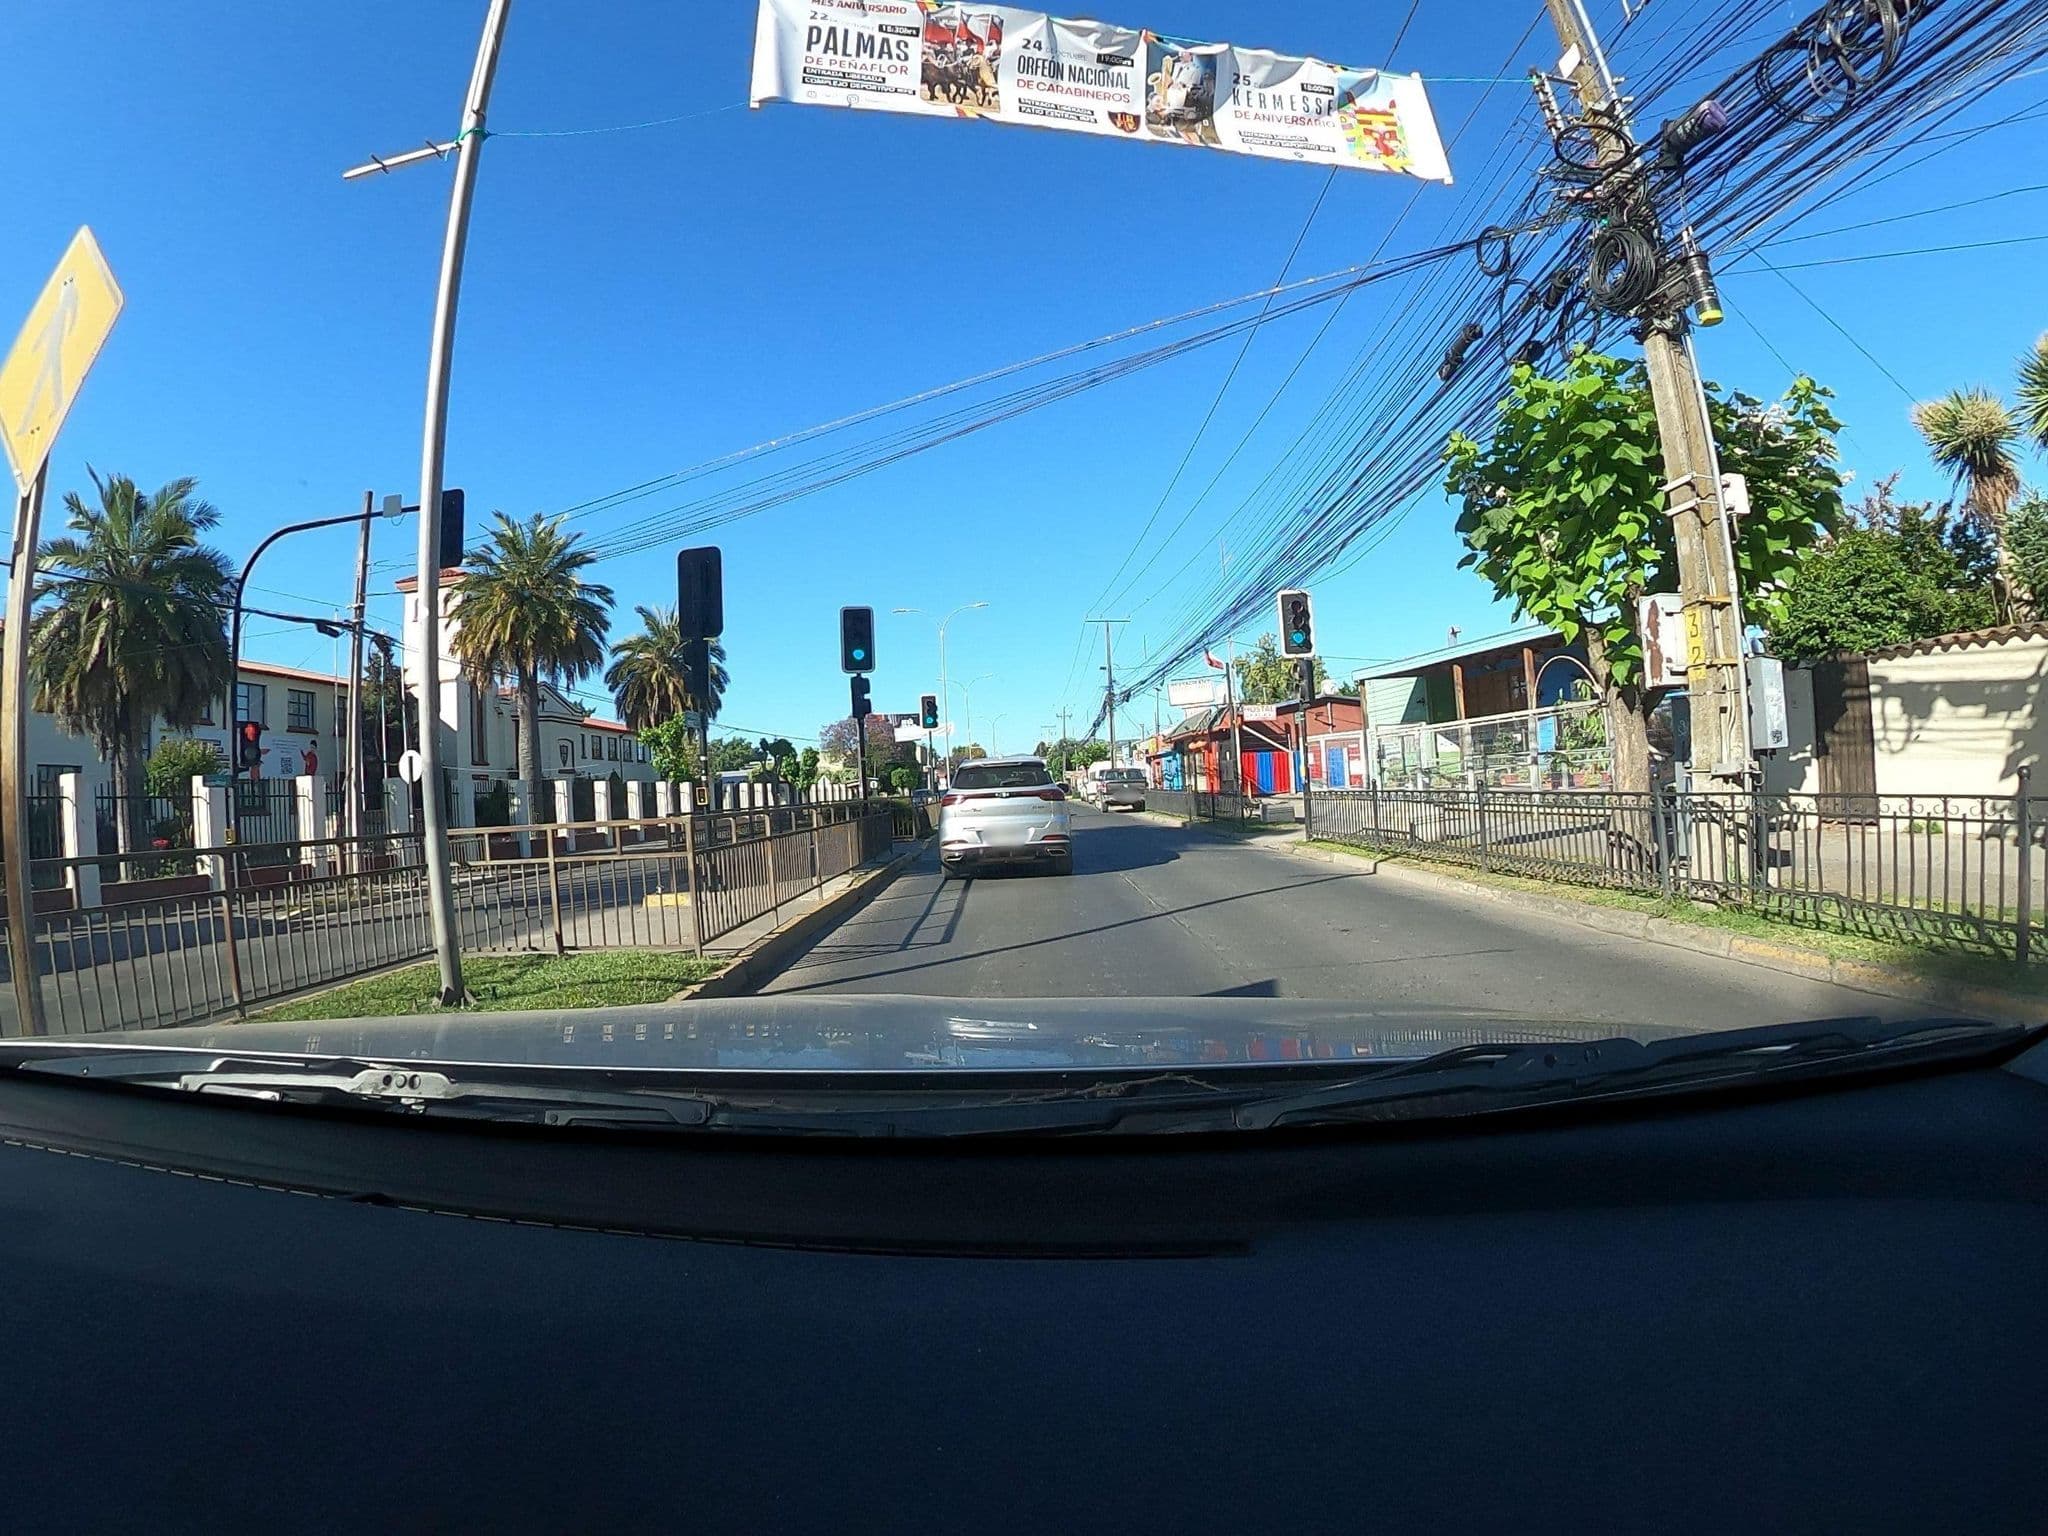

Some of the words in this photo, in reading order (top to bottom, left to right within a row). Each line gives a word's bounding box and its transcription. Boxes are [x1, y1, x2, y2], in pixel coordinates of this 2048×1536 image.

[809, 10, 829, 20] 22
[837, 0, 907, 14] ANIVRSARIO
[806, 26, 909, 61] PALMAS
[1021, 38, 1042, 51] 24
[804, 55, 823, 66] DE
[829, 58, 909, 75] PEÑAFLOR
[806, 67, 843, 77] ENTRADA
[1017, 55, 1064, 80] ORFEÓN
[1068, 64, 1130, 89] NACIONAL
[850, 82, 895, 92] DEPORTIVO
[1232, 73, 1251, 86] 25
[1016, 79, 1034, 90] DE
[1036, 81, 1130, 103] CARABINEROS
[1232, 88, 1333, 116] KERMESSE
[1234, 110, 1250, 120] DE
[1254, 112, 1335, 128] ANIVERSARIO
